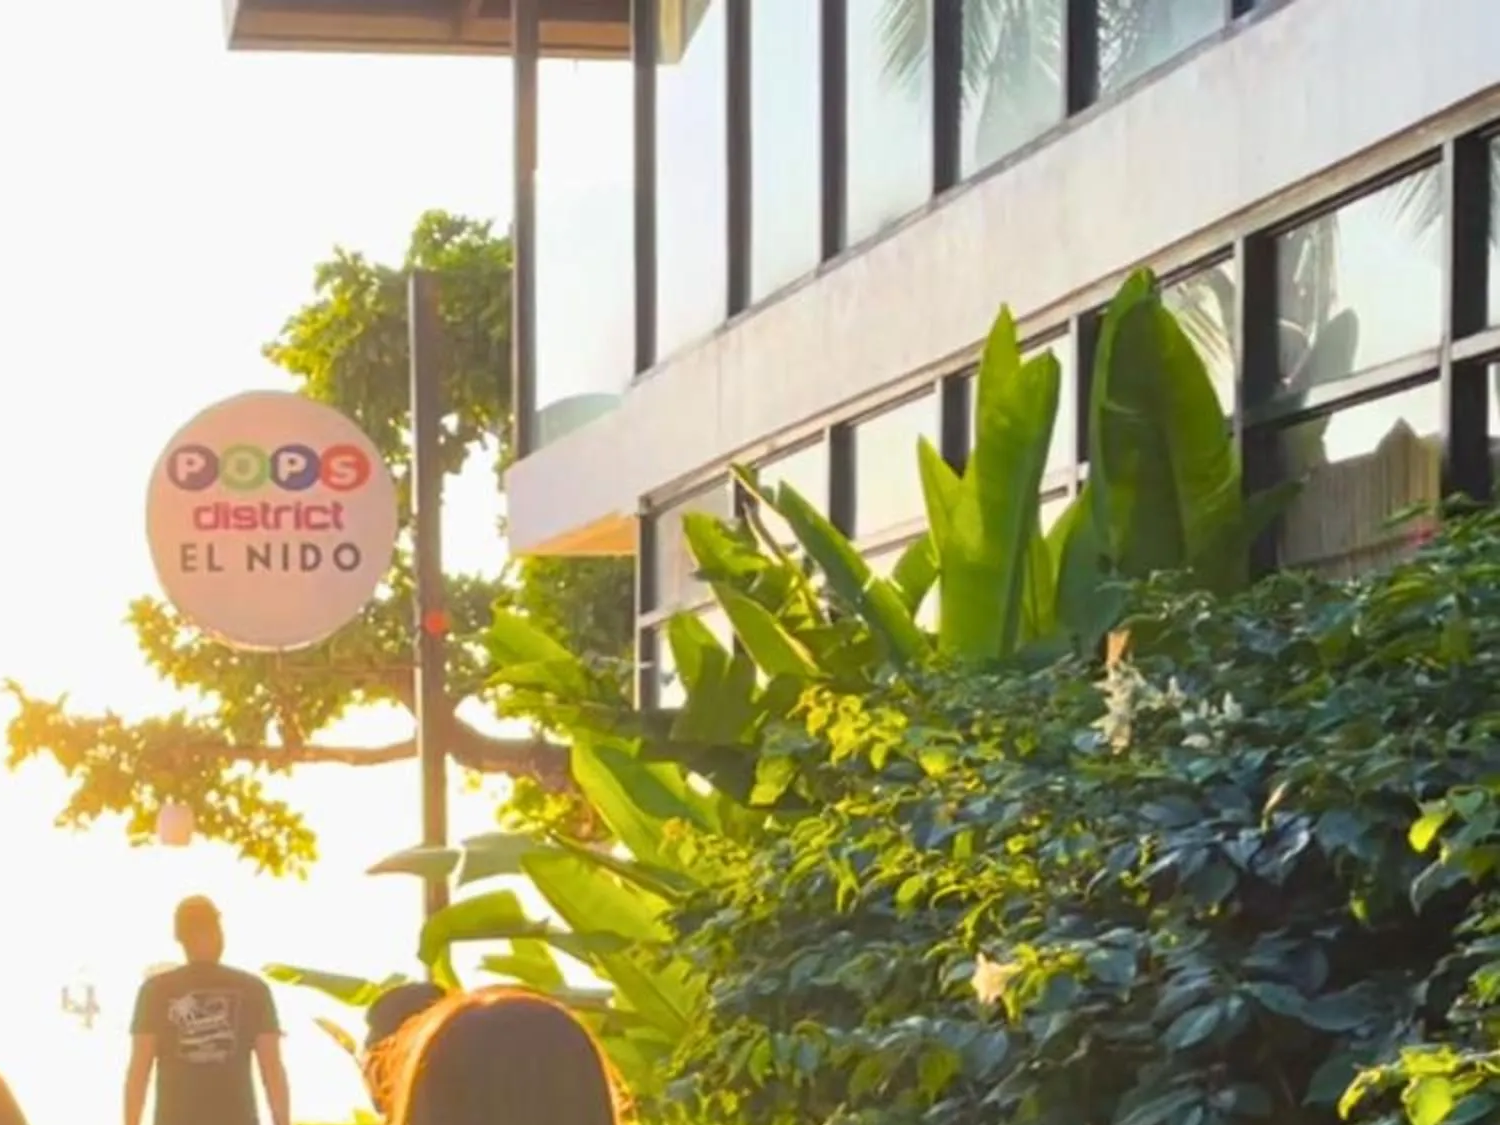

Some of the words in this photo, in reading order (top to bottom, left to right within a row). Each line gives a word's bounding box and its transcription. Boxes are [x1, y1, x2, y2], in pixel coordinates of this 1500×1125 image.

[171, 448, 365, 487] POPS
[193, 501, 345, 531] district
[180, 543, 224, 572] EL
[246, 542, 362, 572] NIDO
